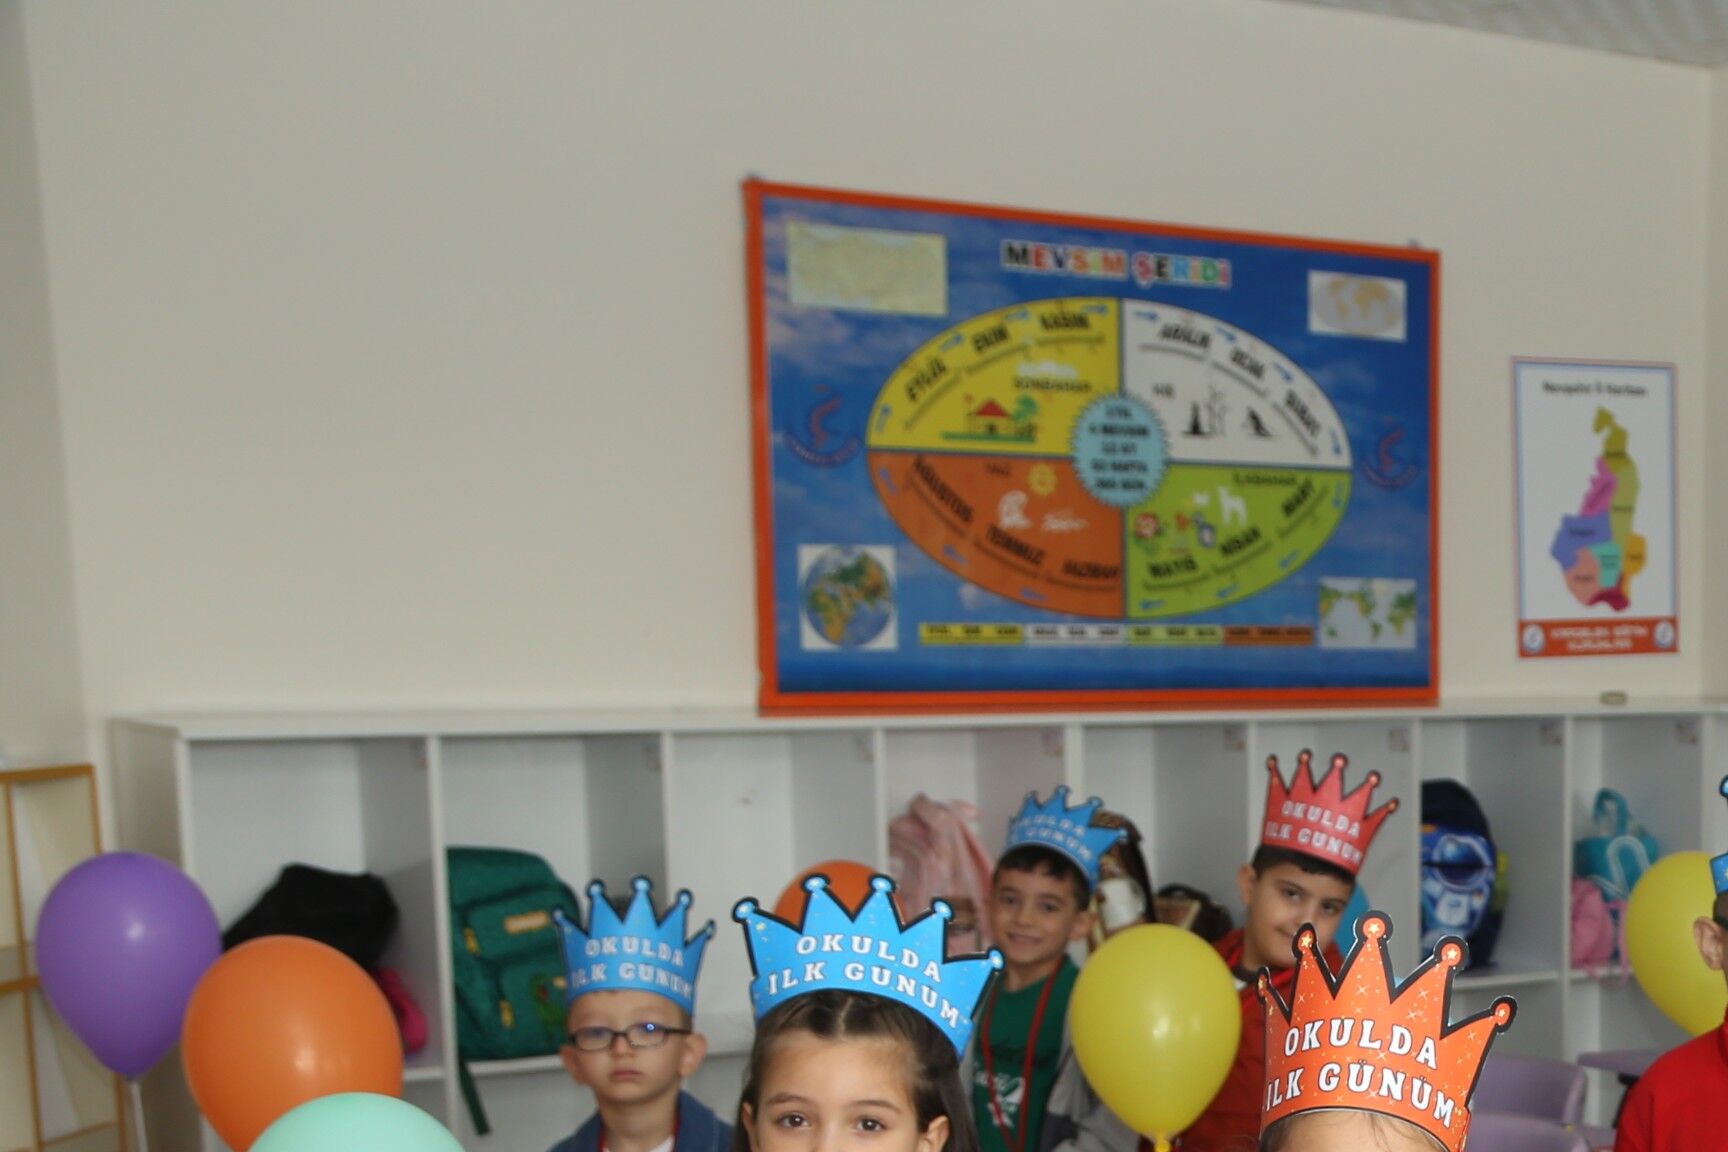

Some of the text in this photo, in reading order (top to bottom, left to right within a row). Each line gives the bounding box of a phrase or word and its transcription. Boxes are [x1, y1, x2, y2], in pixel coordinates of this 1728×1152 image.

[1281, 800, 1361, 838] OKULDA
[585, 936, 684, 967] OKULDA
[796, 934, 942, 983] OKULDA
[1284, 1018, 1438, 1069] OKULDA
